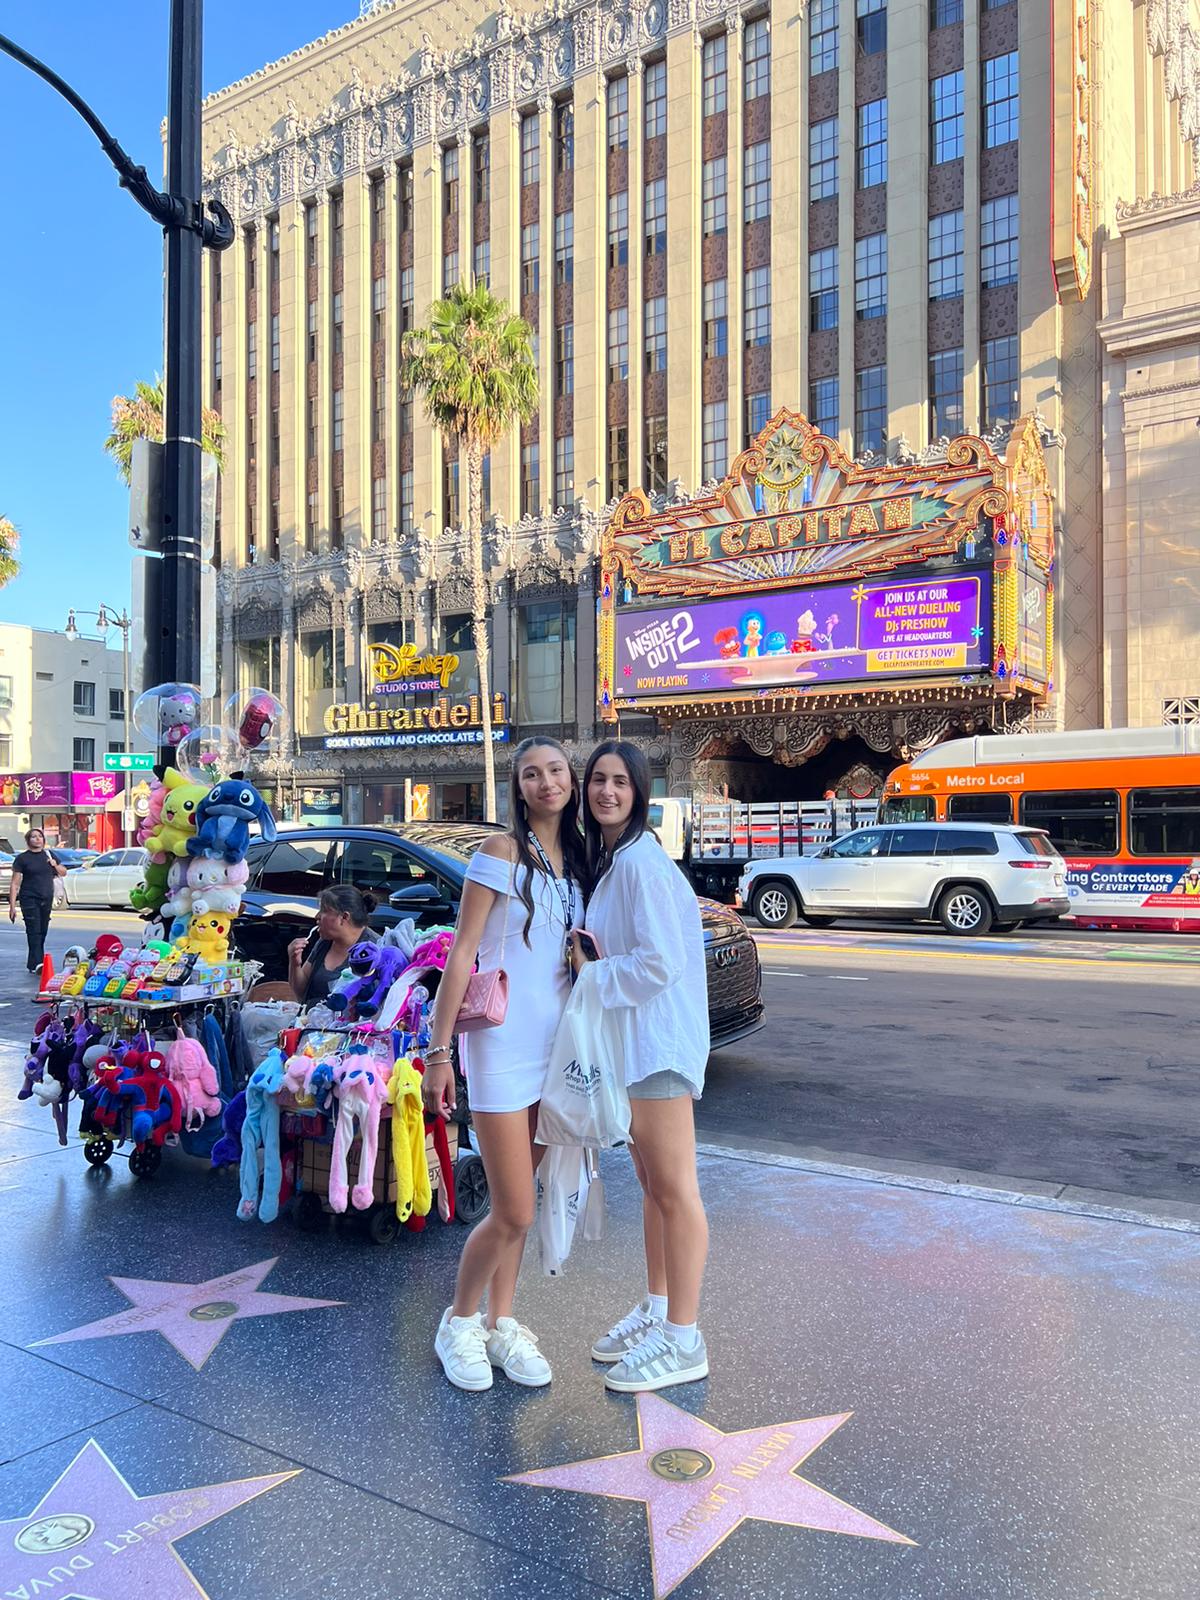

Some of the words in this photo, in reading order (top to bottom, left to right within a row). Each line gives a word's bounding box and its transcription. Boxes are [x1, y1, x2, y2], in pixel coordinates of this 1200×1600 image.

[669, 530, 711, 562] EL
[720, 497, 914, 556] CAPITAN
[884, 592, 903, 606] JOIN
[905, 591, 915, 601] US
[917, 590, 928, 601] AT
[929, 588, 948, 600] OUR
[874, 605, 917, 618] ALL-NEW
[919, 601, 961, 615] DUELING
[885, 621, 899, 633] DJs
[901, 617, 948, 630] PRESHOW
[625, 620, 676, 661] INSIDE
[647, 637, 678, 669] OUT
[671, 611, 701, 654] 2
[883, 634, 895, 643] LIVE
[896, 633, 904, 642] AT
[904, 631, 952, 642] HEADQUARTERS!
[877, 651, 893, 661] GET
[895, 649, 929, 660] TICKETS
[931, 647, 956, 658] NOW!
[368, 642, 460, 689] Disney
[375, 681, 408, 694] STUDIO
[410, 680, 441, 691] STORE
[637, 676, 656, 689] NOW
[657, 674, 688, 688] PLAYING
[323, 692, 508, 734] Ghirardeli
[325, 737, 350, 748] SODA
[350, 735, 395, 748] FOUNTAIN
[395, 734, 416, 745] AND
[417, 732, 475, 745] CHOCOLATE
[476, 730, 504, 742] SOP
[946, 775, 985, 787] Metro
[990, 773, 1024, 786] Local
[1091, 871, 1174, 883] Contractors
[1106, 884, 1137, 892] EVERY
[1138, 884, 1168, 892] TRADE
[731, 1430, 796, 1479] MARTIN
